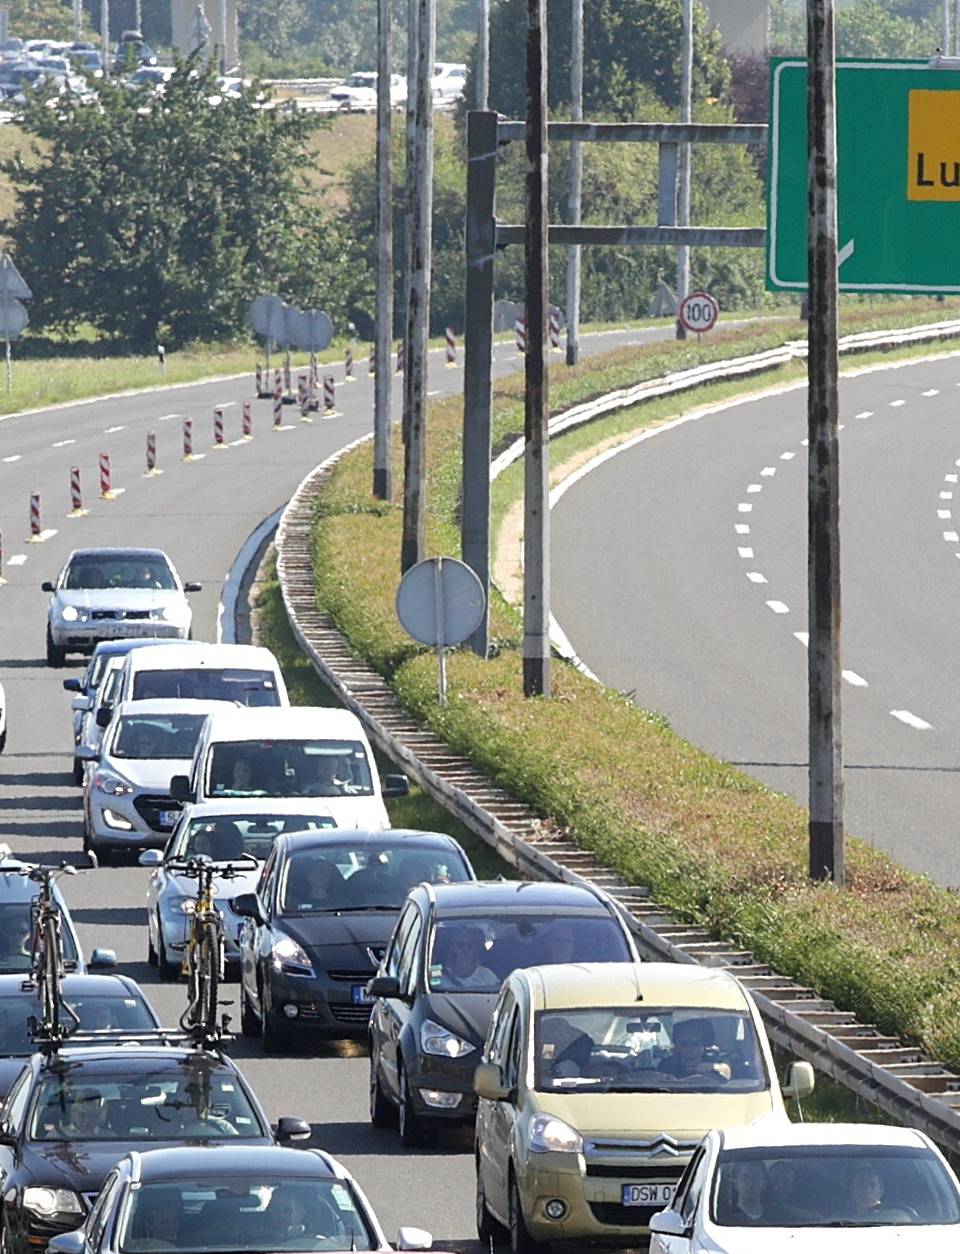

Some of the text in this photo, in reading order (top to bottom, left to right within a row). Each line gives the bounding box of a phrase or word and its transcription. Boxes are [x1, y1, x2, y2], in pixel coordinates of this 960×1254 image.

[687, 303, 711, 322] 100
[631, 1186, 677, 1202] DSW 0
